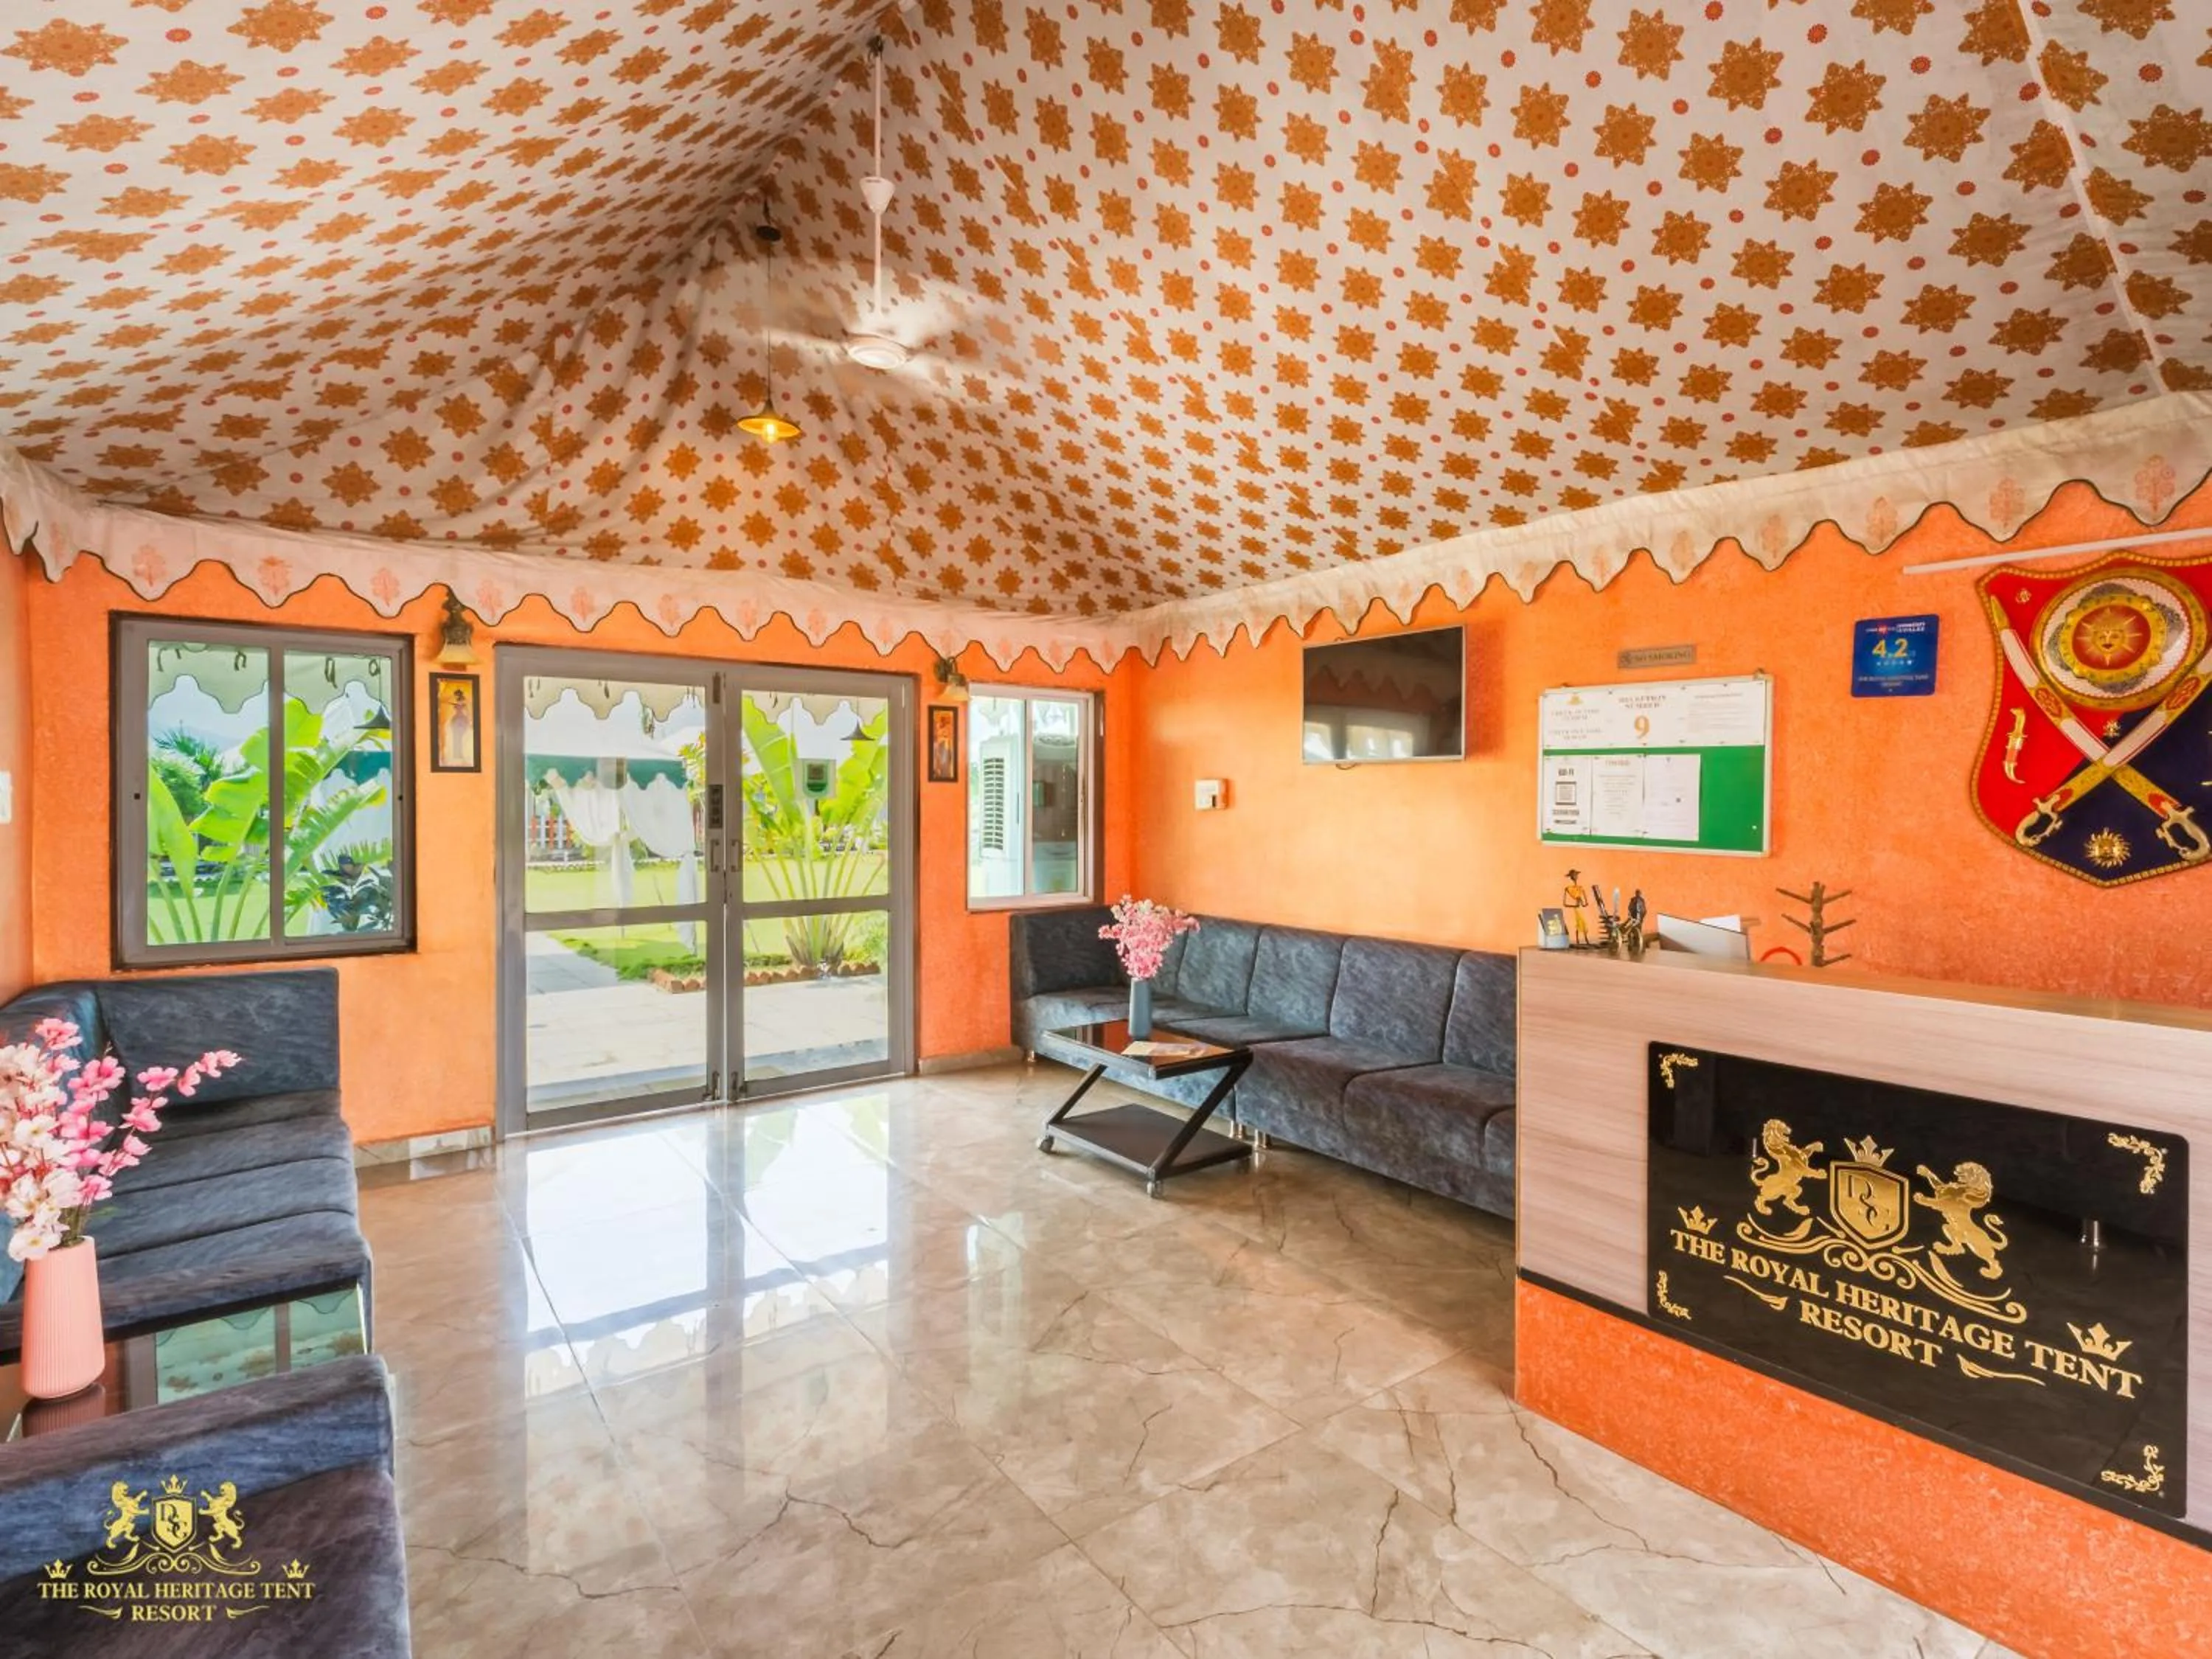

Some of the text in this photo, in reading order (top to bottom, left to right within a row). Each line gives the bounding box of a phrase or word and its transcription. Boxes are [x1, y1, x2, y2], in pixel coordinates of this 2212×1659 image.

[1634, 714, 1650, 739] 9
[1670, 1230, 2143, 1399] THE ROYAL HERITAGE TENT
[1800, 1300, 1943, 1367] RESORT
